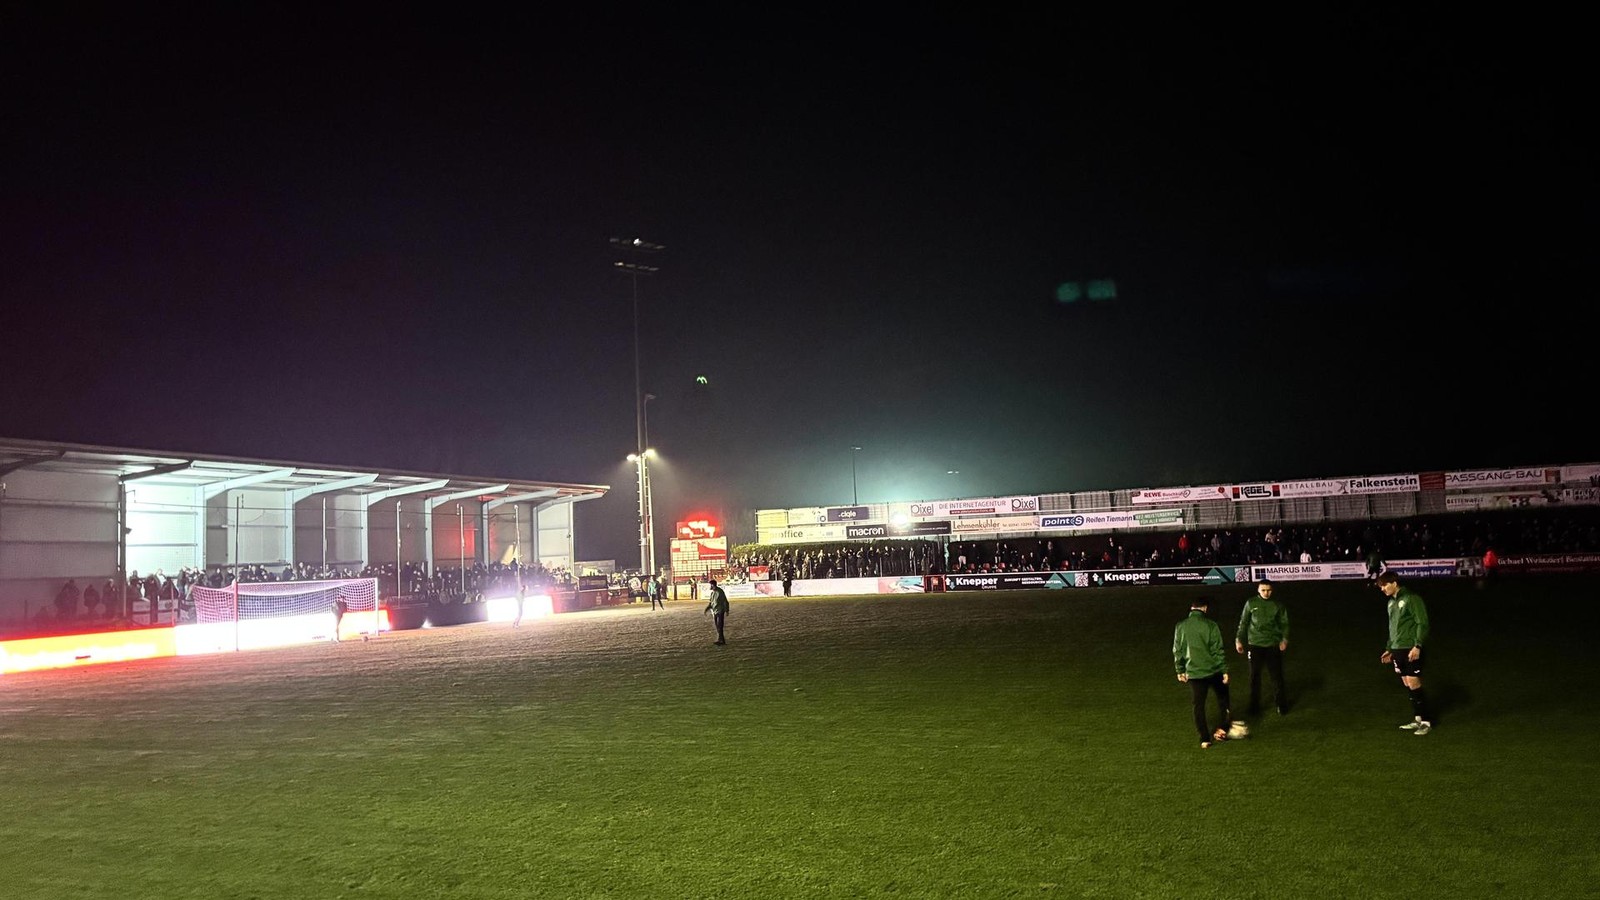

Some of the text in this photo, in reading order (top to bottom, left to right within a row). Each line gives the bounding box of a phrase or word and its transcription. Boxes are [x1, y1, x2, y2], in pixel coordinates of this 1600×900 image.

[1281, 481, 1333, 490] METALLBAU
[1349, 476, 1417, 488] Falkenstein
[1241, 485, 1271, 498] KEGEL
[949, 500, 1007, 509] INTERNETAGENTUR
[952, 519, 1001, 530] Lehmenkühler
[1044, 517, 1071, 526] point
[1106, 515, 1133, 523] Tiemann
[849, 526, 885, 537] macron
[1266, 566, 1300, 574] MARKUS
[1301, 565, 1321, 573] MIES
[955, 577, 998, 587] Knepper
[1104, 572, 1151, 582] Knepper
